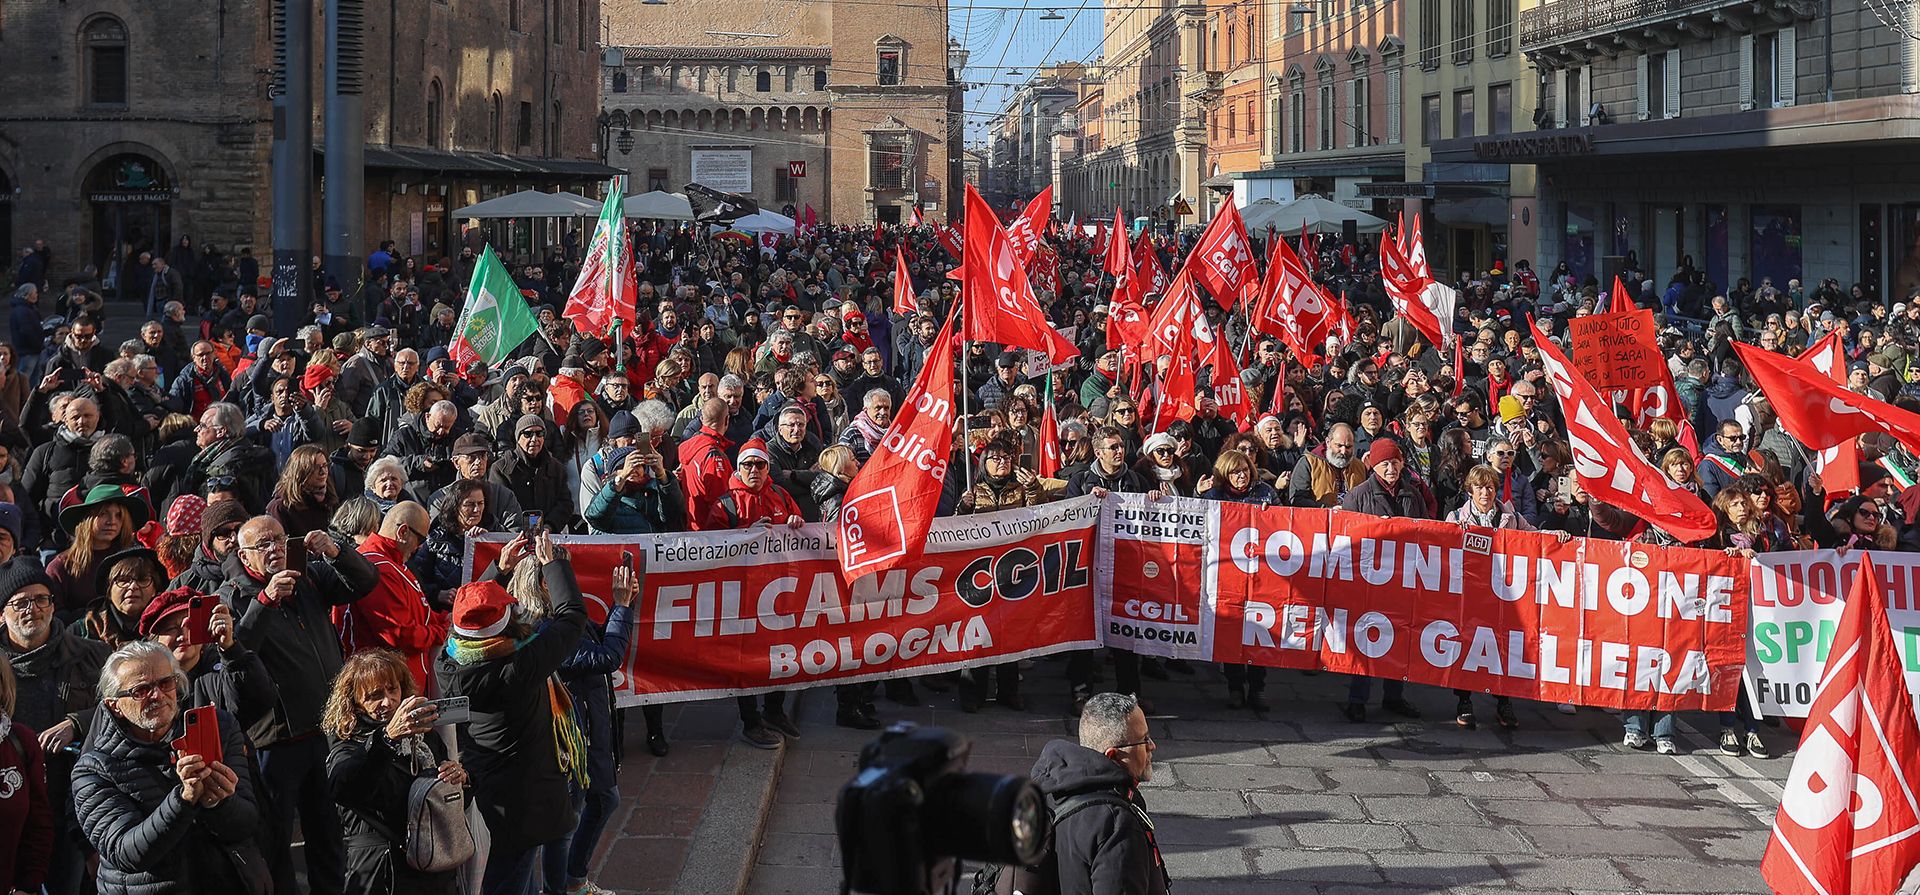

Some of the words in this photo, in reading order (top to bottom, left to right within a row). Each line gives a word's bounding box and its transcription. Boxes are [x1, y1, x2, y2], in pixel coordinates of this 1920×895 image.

[790, 163, 805, 175] W
[1212, 250, 1239, 285] CGIL
[1611, 316, 1641, 332] TUTTO
[1599, 334, 1637, 348] PRIVATO
[1616, 366, 1646, 380] TUTTO
[1114, 509, 1204, 526] FUNZIONE
[655, 540, 759, 562] Federazione
[763, 533, 820, 554] Italiana
[926, 524, 991, 544] mmercio
[991, 516, 1049, 537] Turismo
[1060, 503, 1102, 523] Serviz
[844, 506, 867, 565] CGIL
[1114, 523, 1203, 540] PUBBLICA
[1466, 535, 1489, 550] AGD
[1230, 527, 1464, 595] COMUNI
[1491, 552, 1734, 623] UNIONE
[653, 566, 943, 641] FILCAMS
[955, 539, 1089, 608] CGIL
[1124, 599, 1189, 622] CGIL
[1110, 621, 1198, 645] BOLOGNA
[769, 615, 993, 680] BOLOGNA
[1242, 600, 1395, 659] RENO
[1420, 620, 1712, 695] GALLIERA
